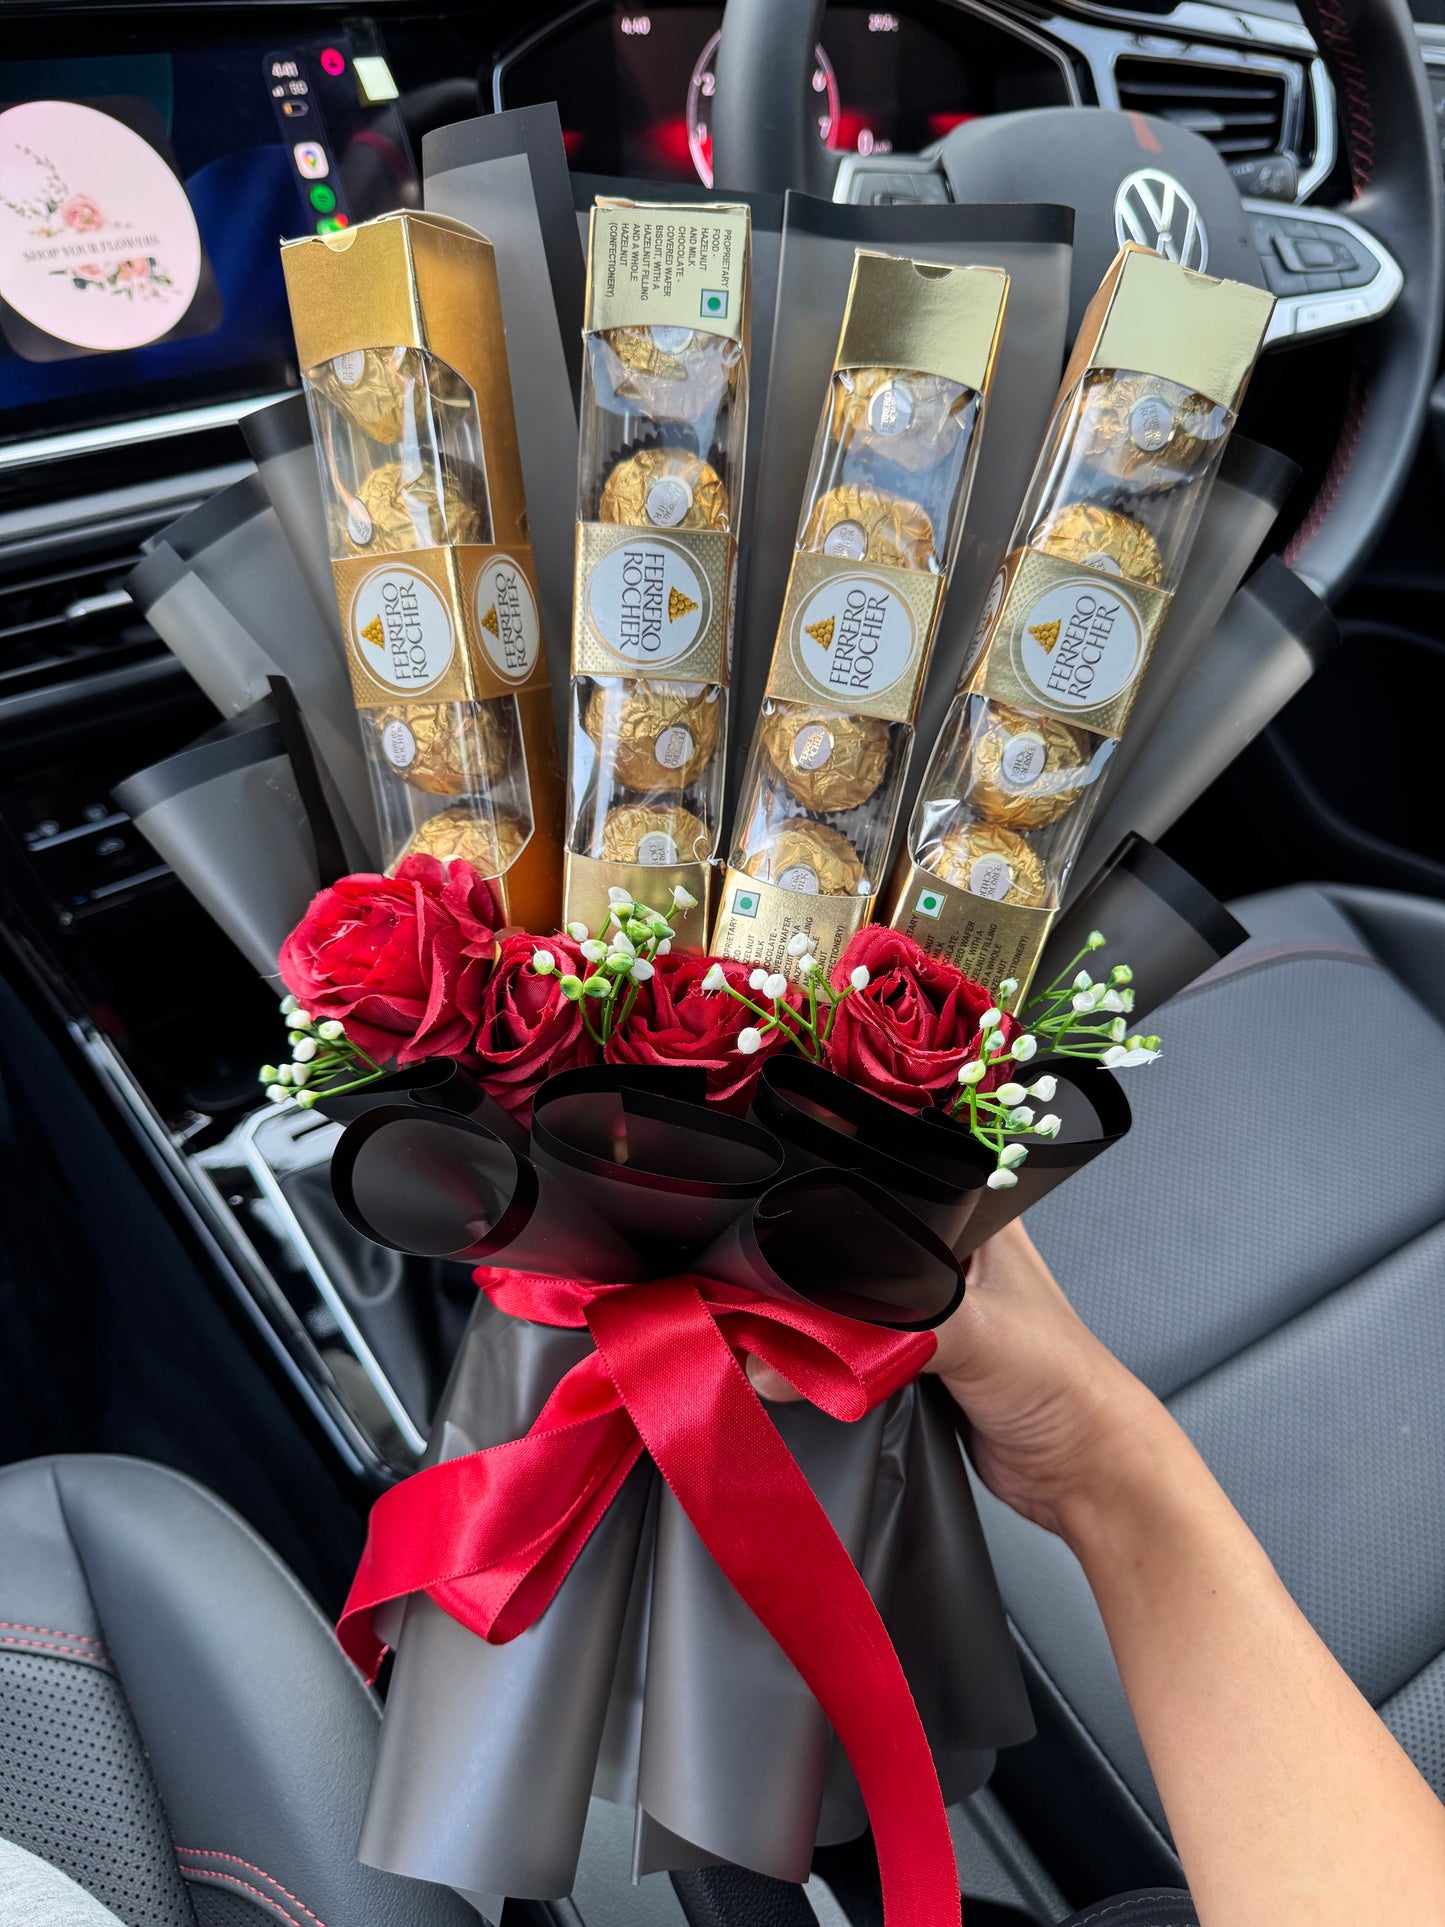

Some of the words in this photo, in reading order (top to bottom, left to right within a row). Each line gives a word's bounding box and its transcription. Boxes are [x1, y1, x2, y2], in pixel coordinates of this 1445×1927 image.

[619, 223, 629, 266] HAZELNUT
[632, 223, 640, 241] AND
[642, 224, 651, 267] HAZELNUT
[665, 225, 674, 265] COVERED
[676, 226, 686, 277] CHOCOLATE
[688, 226, 697, 244] AND
[699, 227, 709, 271] HAZELNUT
[712, 228, 720, 252] FOOD
[604, 222, 618, 297] (CONFECTIONERY)
[630, 251, 639, 281] WHOLE
[653, 261, 661, 282] WITH
[688, 246, 696, 266] MILK
[721, 229, 732, 287] PROPRIETARY
[641, 269, 649, 301] FILLING
[664, 267, 672, 296] WAFER
[495, 573, 517, 669] FERRERO
[507, 573, 528, 668] ROCHER
[620, 552, 643, 650] ROCHER
[641, 552, 665, 652] FERRERO
[382, 582, 411, 680] FERRERO
[400, 580, 429, 679] ROCHER
[829, 589, 867, 686] FERRERO
[850, 594, 890, 689] ROCHER
[1047, 595, 1096, 693] FERRERO
[1067, 605, 1120, 700] ROCHER
[663, 729, 678, 764] ROCHER
[670, 730, 685, 766] FERRERO
[1010, 750, 1026, 778] OCHER
[979, 866, 993, 897] OCHER
[721, 916, 737, 962] ROPRIETARY
[754, 939, 765, 958] MILK
[761, 931, 777, 972] HOCOLATE
[772, 944, 785, 974] OVERED
[779, 916, 791, 943] WAFER
[931, 940, 944, 959] MILK
[959, 919, 975, 948] WAFER
[967, 935, 981, 956] WITH
[969, 951, 987, 984] AZELNUT
[980, 922, 998, 952] FILLING
[979, 977, 989, 988] ND
[985, 942, 1002, 970] WHOLE
